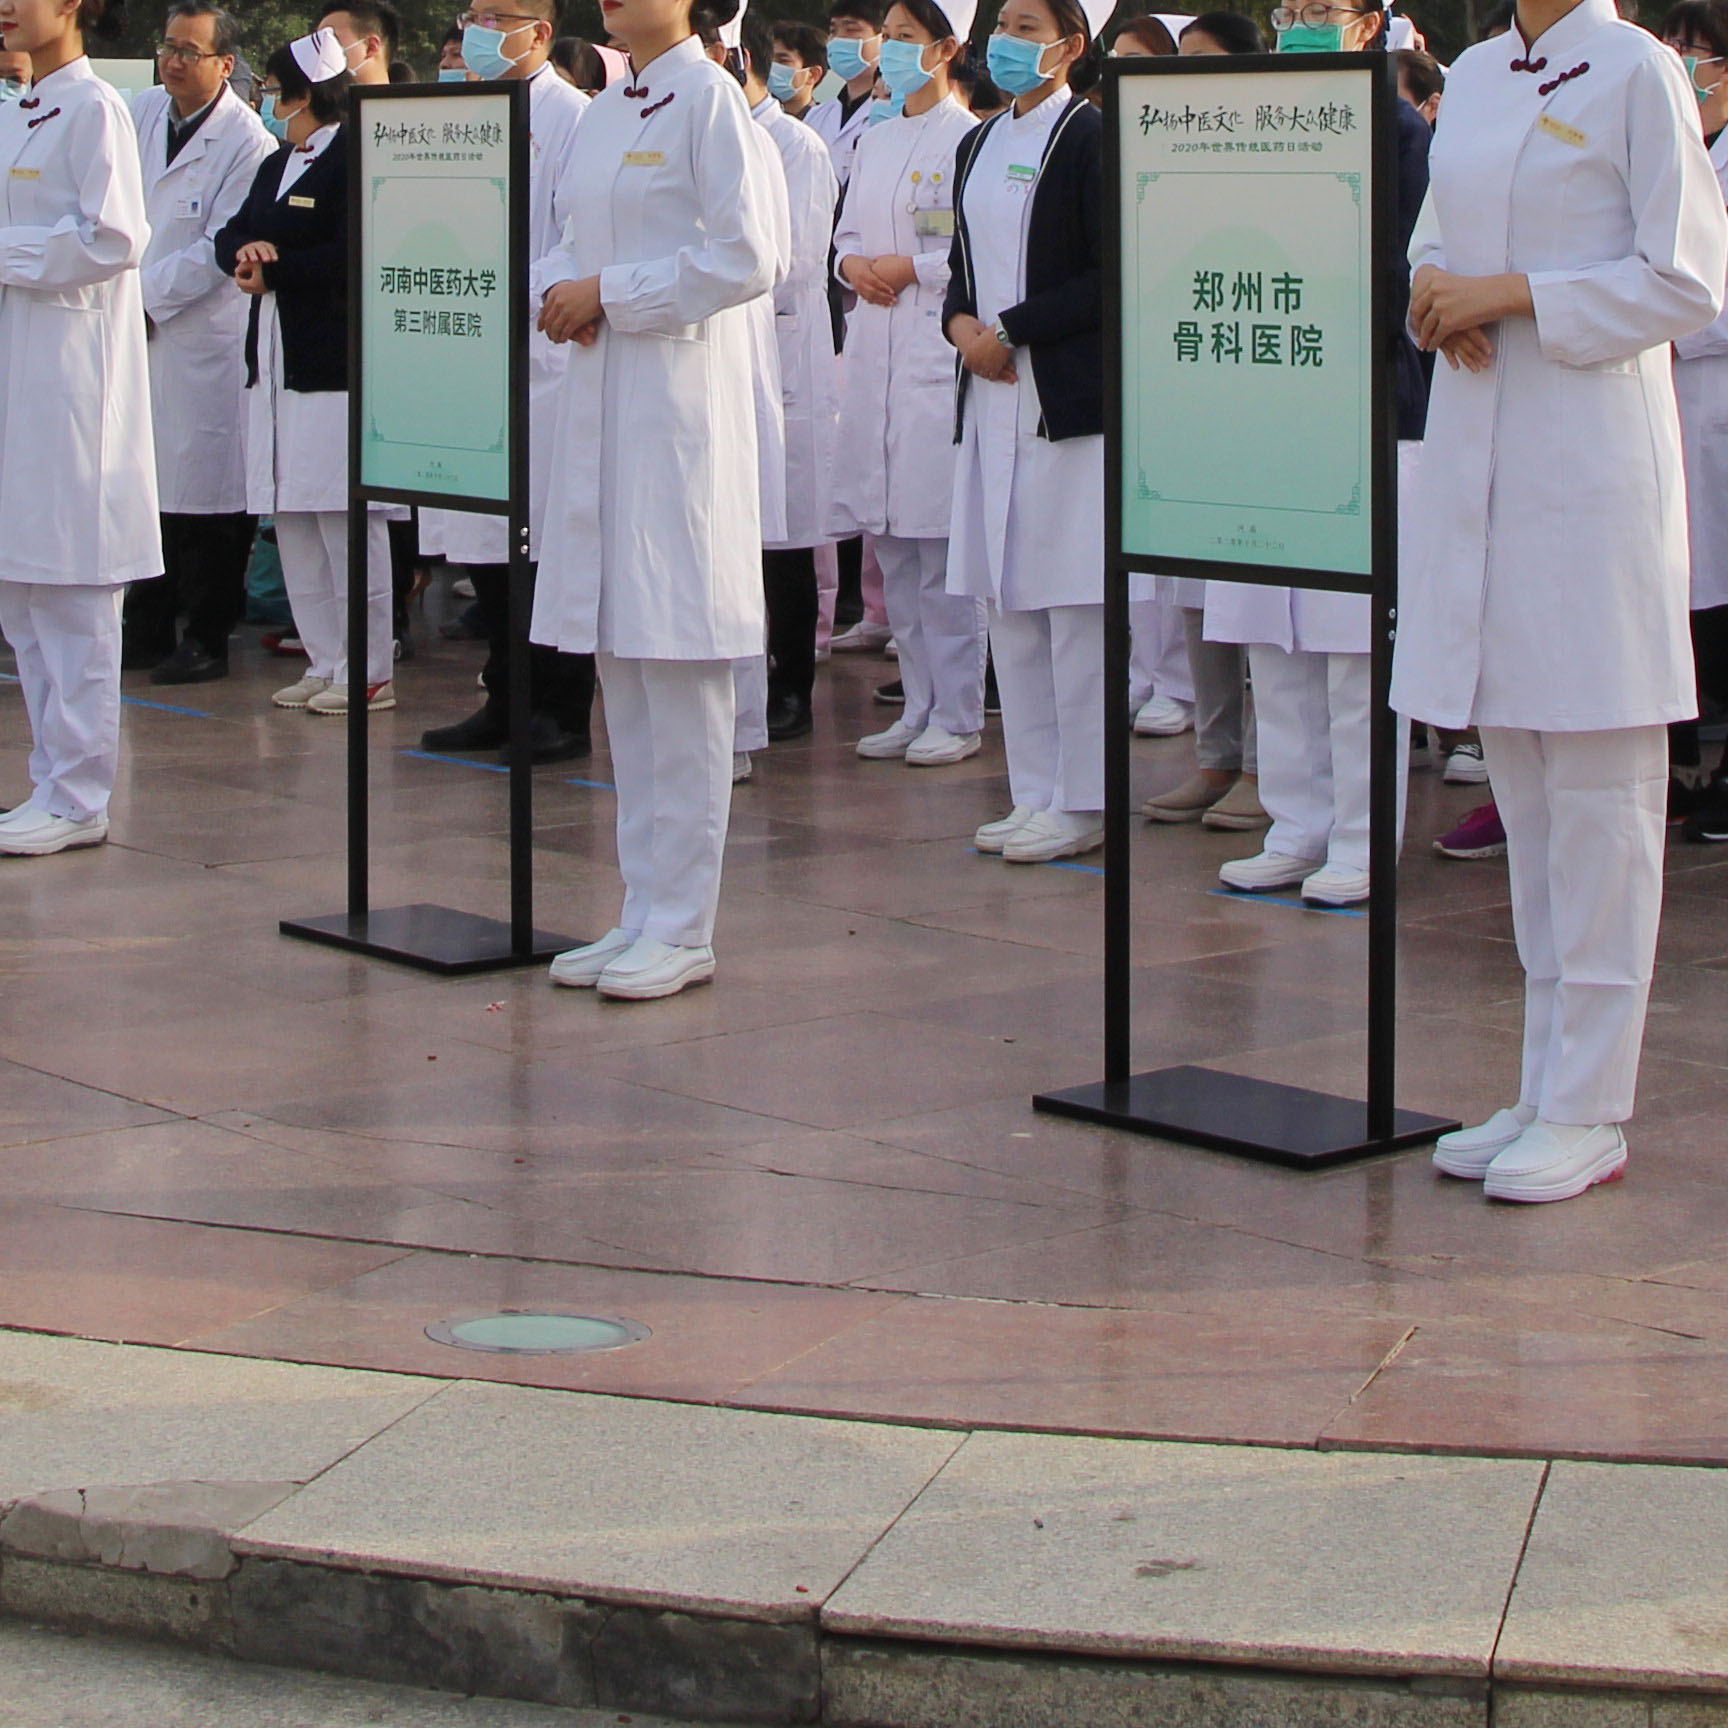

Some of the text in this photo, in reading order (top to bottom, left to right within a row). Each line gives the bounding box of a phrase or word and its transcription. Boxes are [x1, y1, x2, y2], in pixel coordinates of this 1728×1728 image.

[1139, 101, 1358, 136] 弘扬中医文化 服务大众健康
[380, 266, 497, 298] 河南中医药大学
[1191, 270, 1304, 315] 郑州市
[393, 308, 483, 339] 第三附属医院
[1173, 321, 1325, 368] 骨科医院
